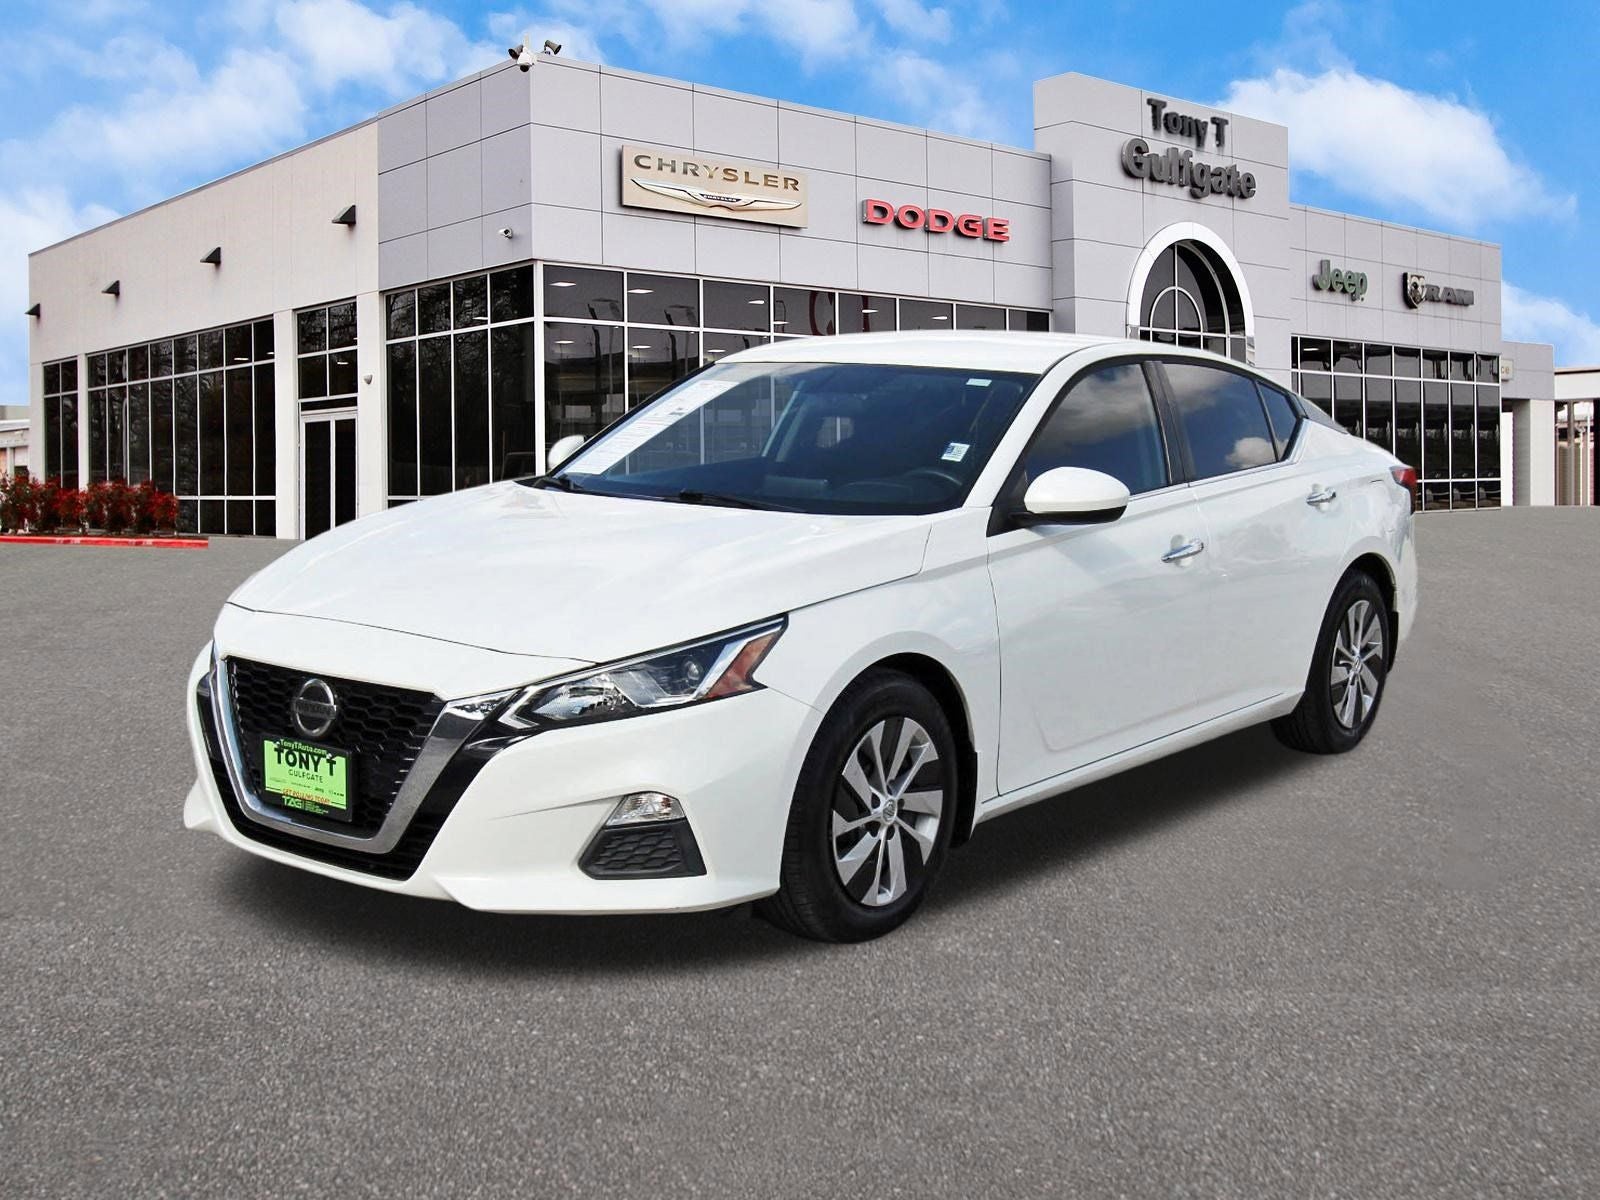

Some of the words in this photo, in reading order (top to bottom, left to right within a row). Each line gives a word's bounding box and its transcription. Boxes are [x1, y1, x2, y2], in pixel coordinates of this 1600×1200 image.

[1146, 98, 1208, 147] Tony
[1210, 116, 1229, 147] T
[633, 154, 800, 191] CHRYSLER
[1121, 138, 1257, 199] Gulfgate
[862, 199, 1010, 242] DODGE
[1312, 259, 1368, 302] Jeep
[1425, 284, 1475, 307] RAM
[274, 747, 321, 772] TONY
[326, 758, 336, 776] T
